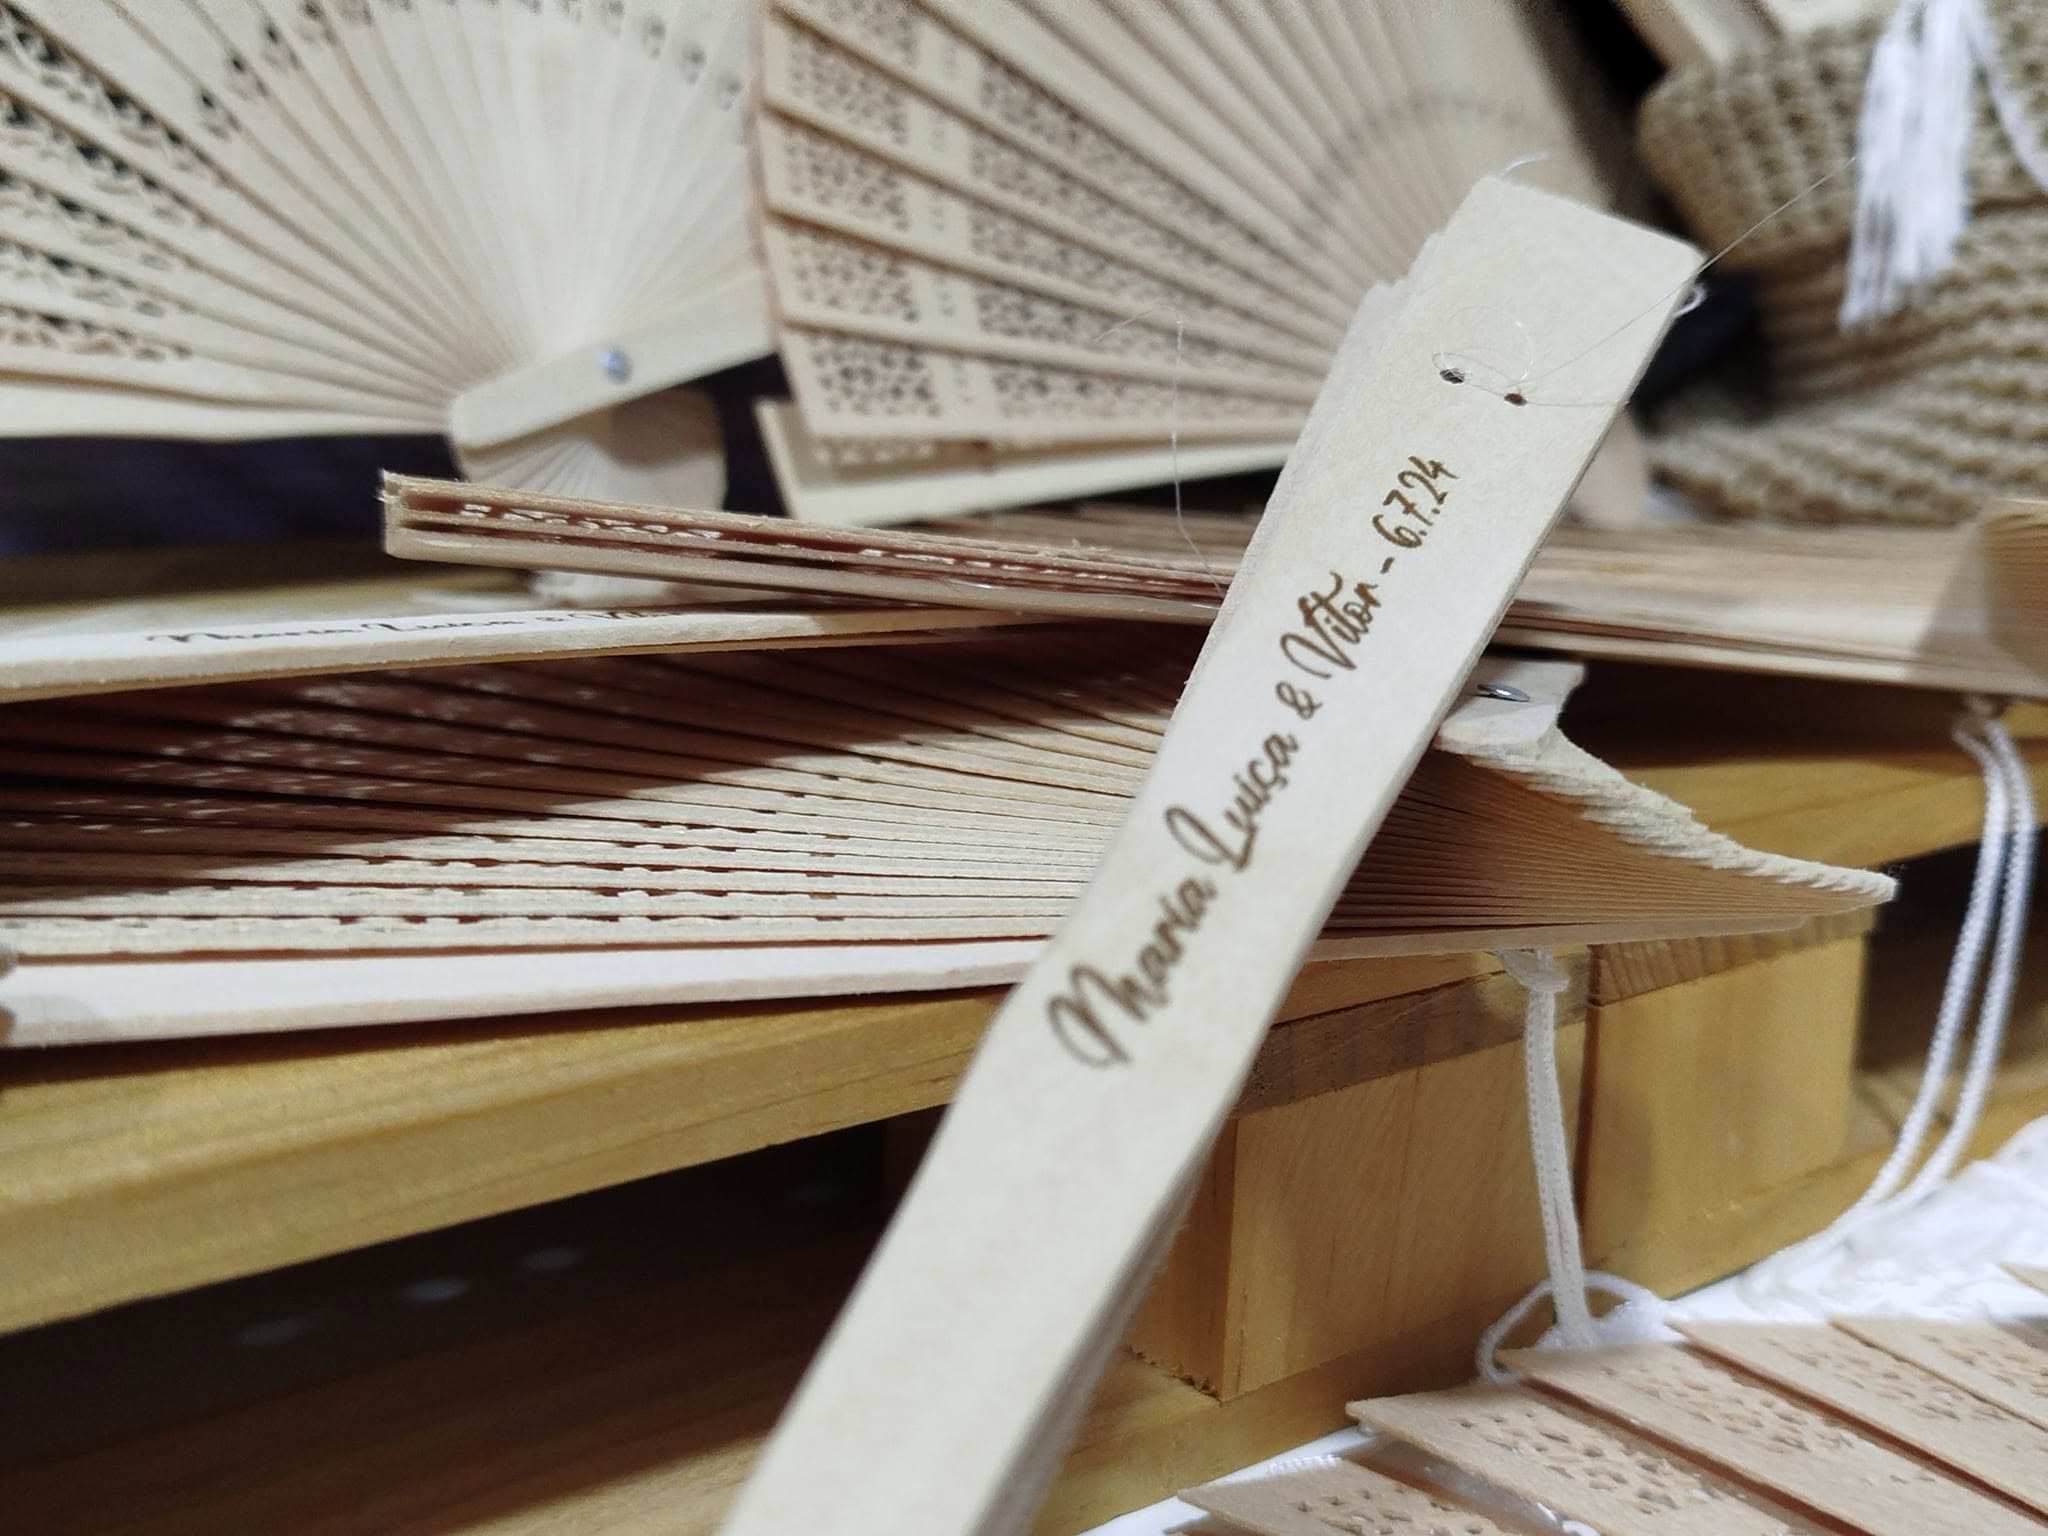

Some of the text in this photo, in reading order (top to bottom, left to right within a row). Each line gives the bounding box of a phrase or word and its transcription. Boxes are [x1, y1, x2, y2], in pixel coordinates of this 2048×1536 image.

[1371, 455, 1459, 549] 6.7.24
[1379, 556, 1396, 575] -
[1279, 570, 1383, 680] Vitor
[1275, 682, 1324, 720] &
[1046, 876, 1217, 1068] Maria
